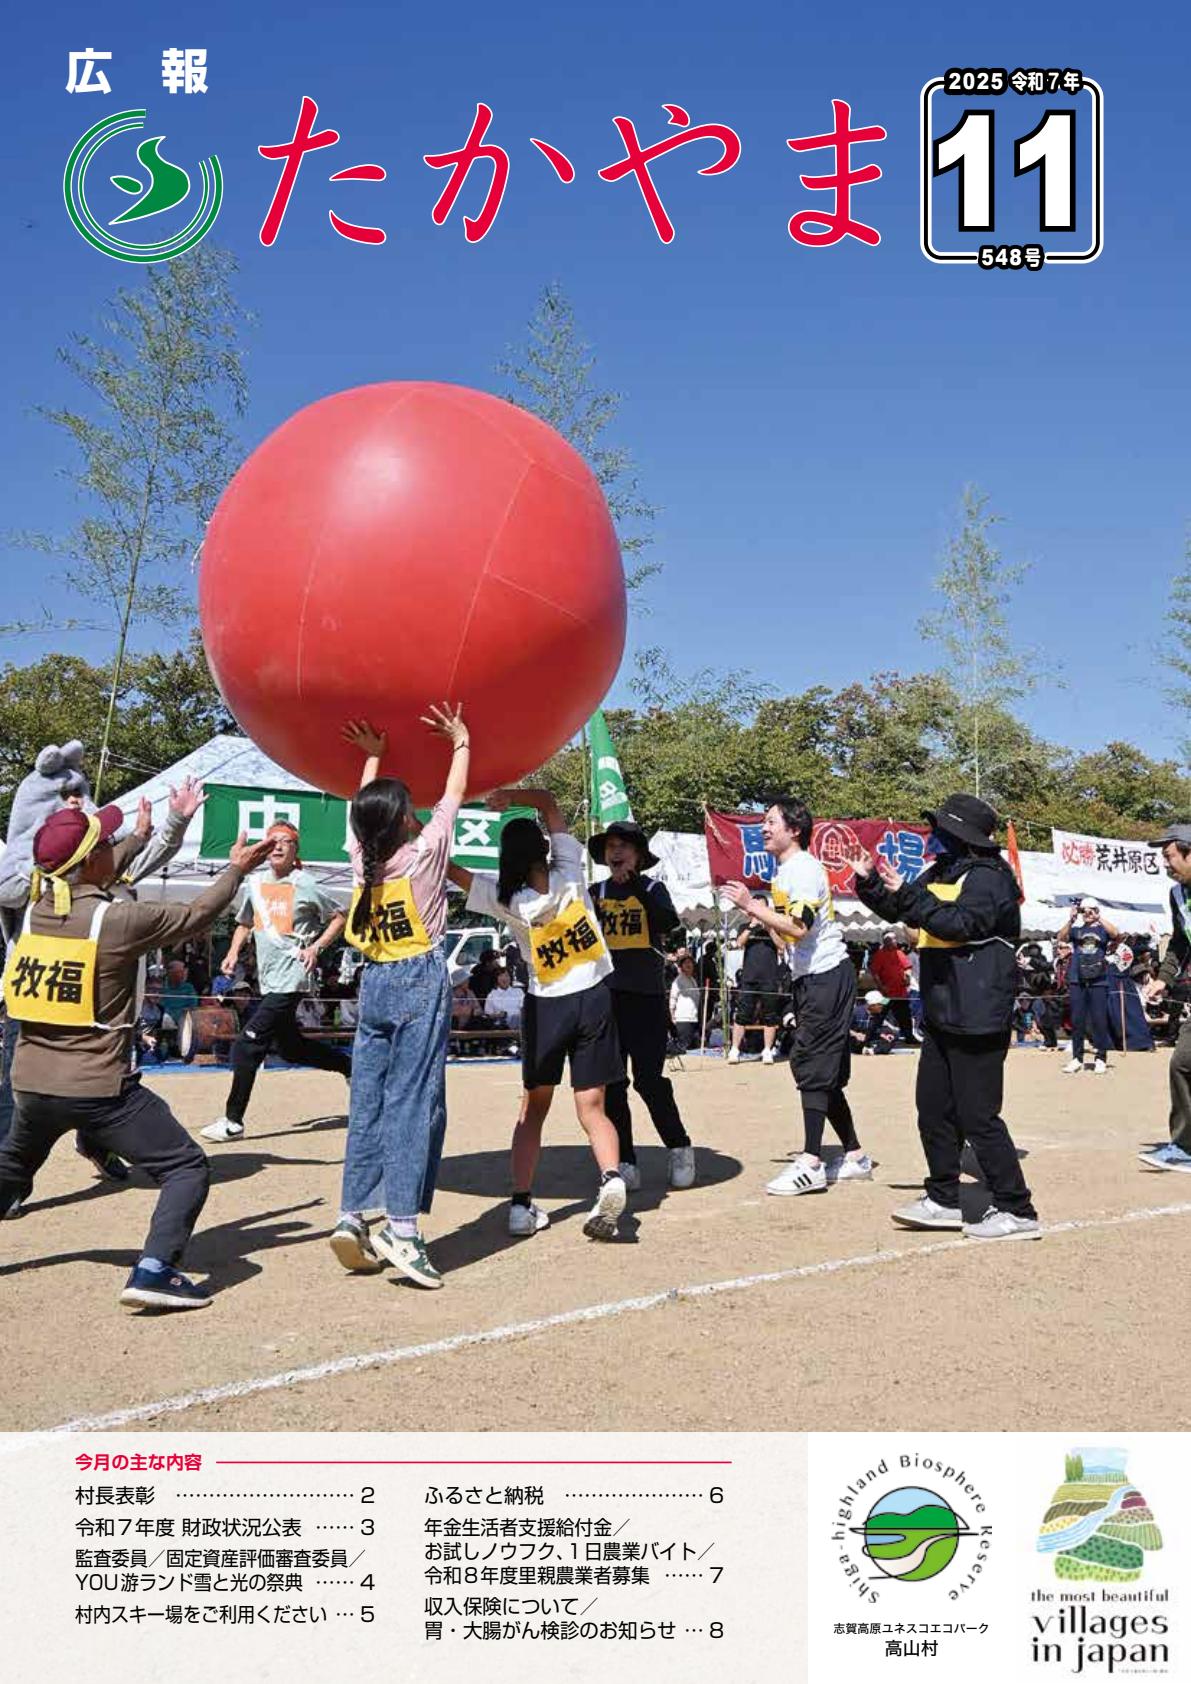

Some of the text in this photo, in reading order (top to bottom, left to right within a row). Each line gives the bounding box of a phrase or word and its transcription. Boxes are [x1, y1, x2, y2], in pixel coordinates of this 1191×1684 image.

[239, 795, 499, 857] 中区
[536, 915, 598, 969] 牧福
[11, 956, 85, 1004] 牧福
